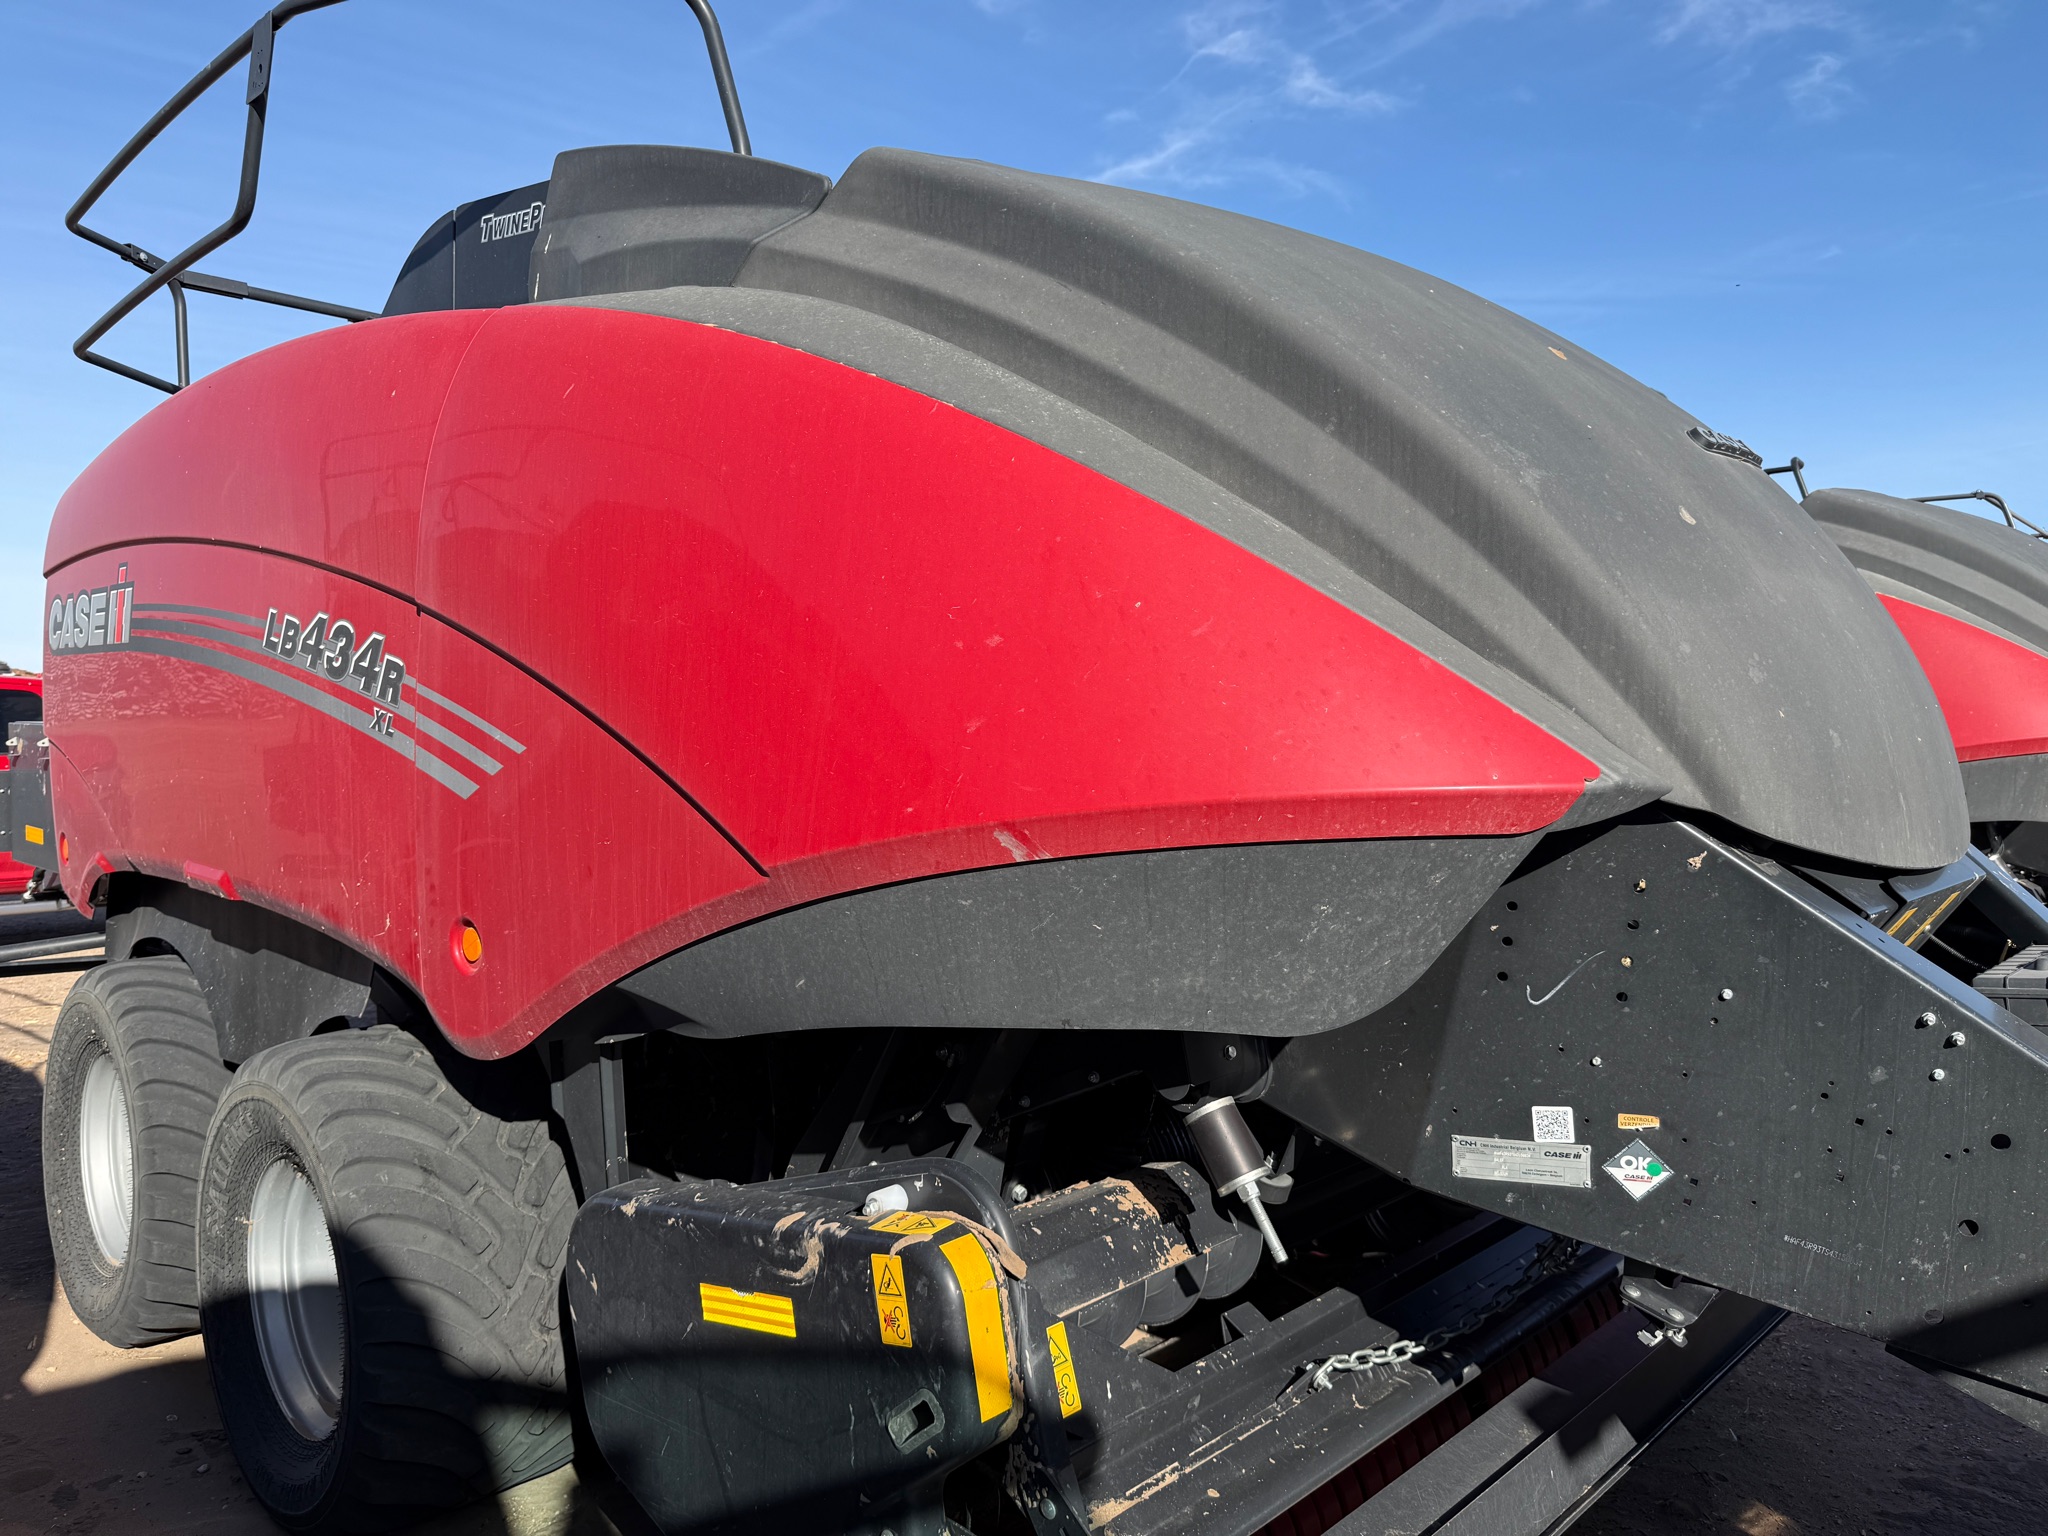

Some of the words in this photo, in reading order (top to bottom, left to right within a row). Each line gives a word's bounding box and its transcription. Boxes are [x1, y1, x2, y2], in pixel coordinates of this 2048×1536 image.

[481, 201, 546, 243] TWINEP
[262, 607, 405, 708] LB434R
[369, 706, 395, 738] XL
[1544, 1151, 1572, 1159] CASE
[1620, 1155, 1653, 1171] OK
